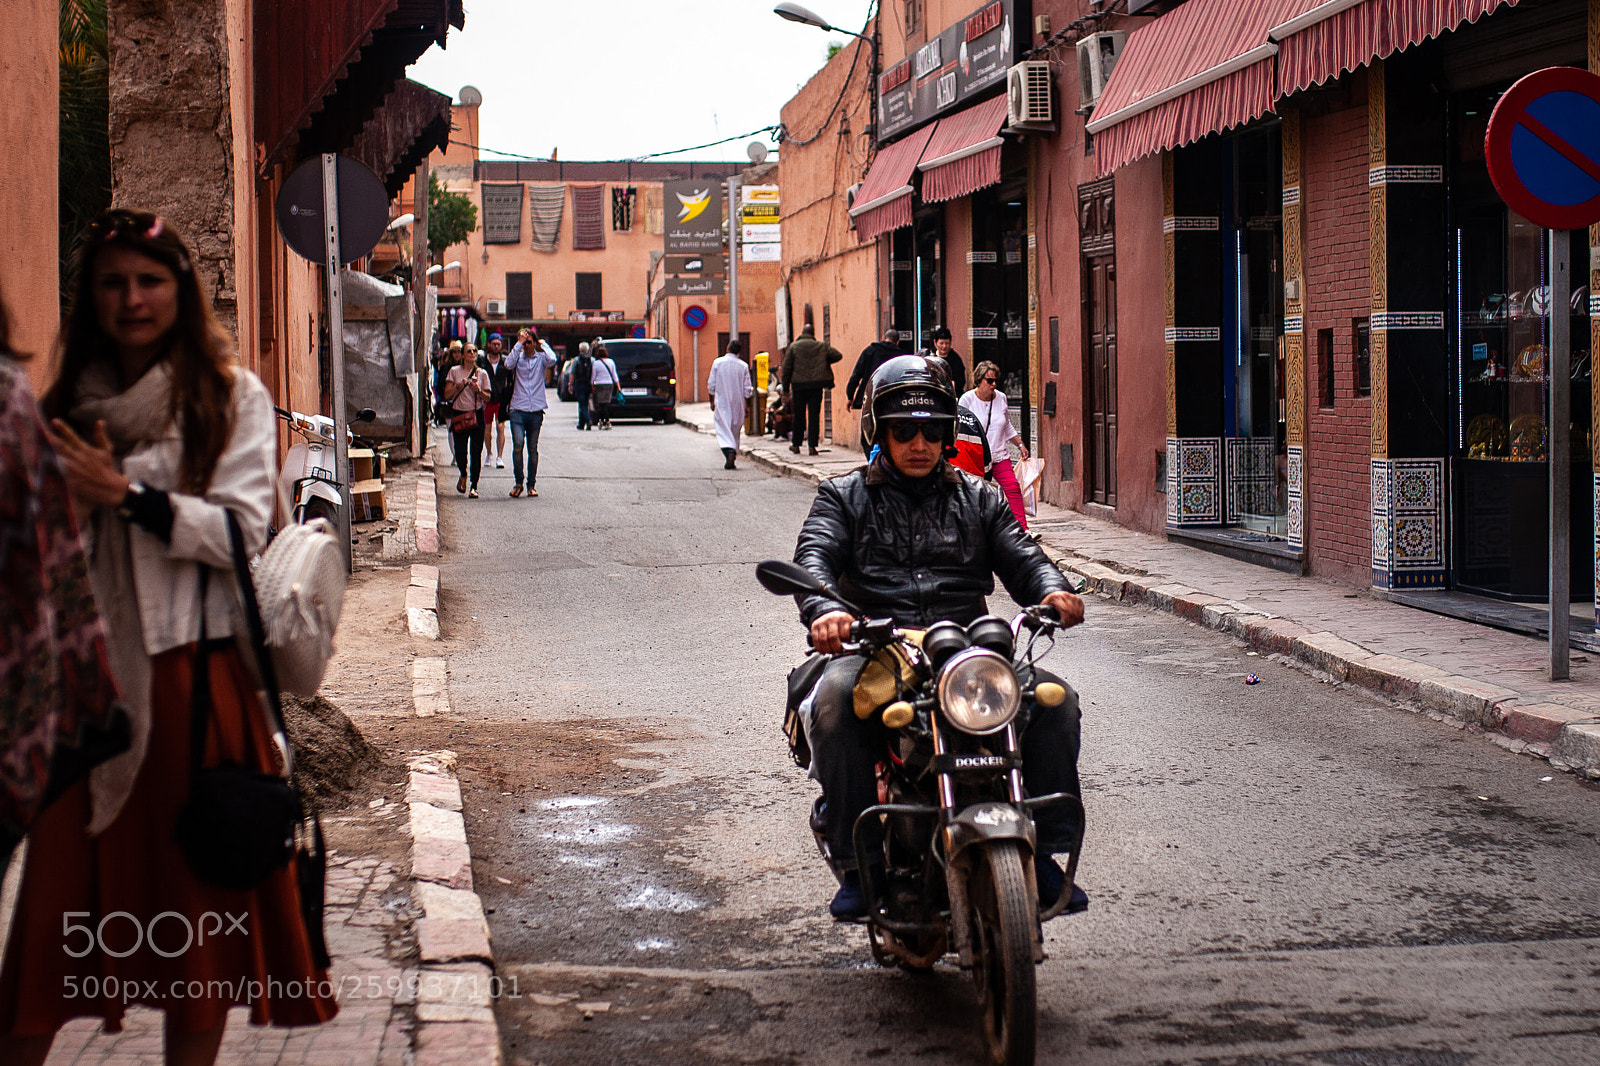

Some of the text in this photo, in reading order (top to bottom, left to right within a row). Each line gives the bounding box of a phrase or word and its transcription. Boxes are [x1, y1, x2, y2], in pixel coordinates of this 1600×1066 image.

[677, 280, 712, 293] الصرف
[901, 397, 935, 406] adidas
[955, 756, 1004, 767] DOCKER
